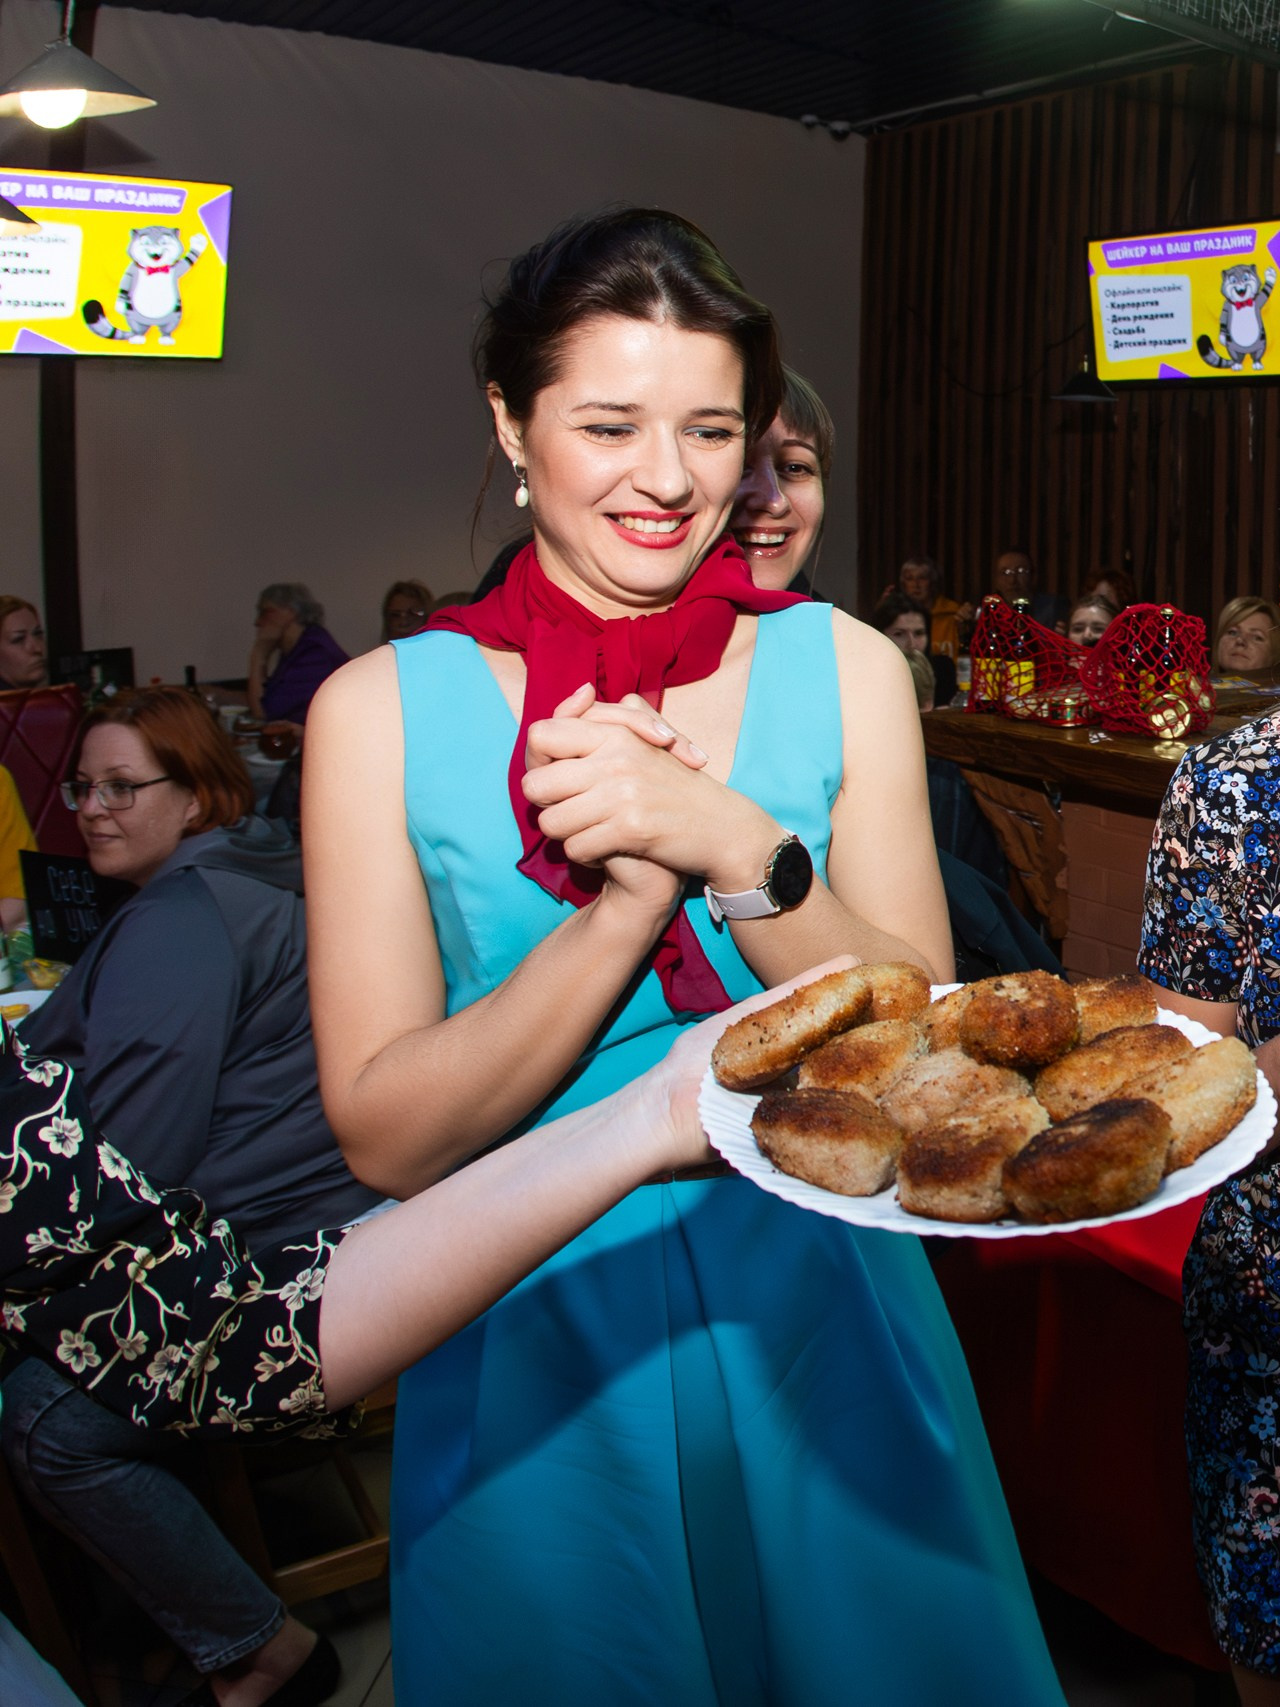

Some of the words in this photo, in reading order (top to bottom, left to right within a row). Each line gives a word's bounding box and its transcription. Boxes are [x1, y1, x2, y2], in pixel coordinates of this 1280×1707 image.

[26, 184, 48, 199] НА
[52, 185, 91, 202] ВАШ
[94, 188, 181, 208] ПРАЗДНИК
[1107, 246, 1147, 261] ШЕЙКЕР
[1150, 244, 1164, 257] НА
[1166, 241, 1191, 255] ВАШ
[1193, 235, 1253, 251] ПРАЗДНИК
[1104, 287, 1135, 298] Офлайн
[1110, 299, 1159, 310] Корпоратив
[1111, 314, 1131, 323] День
[1132, 312, 1174, 323] рождения
[1112, 325, 1145, 335] Свадьба
[1113, 338, 1147, 349] Детский
[1148, 337, 1187, 348] праздник
